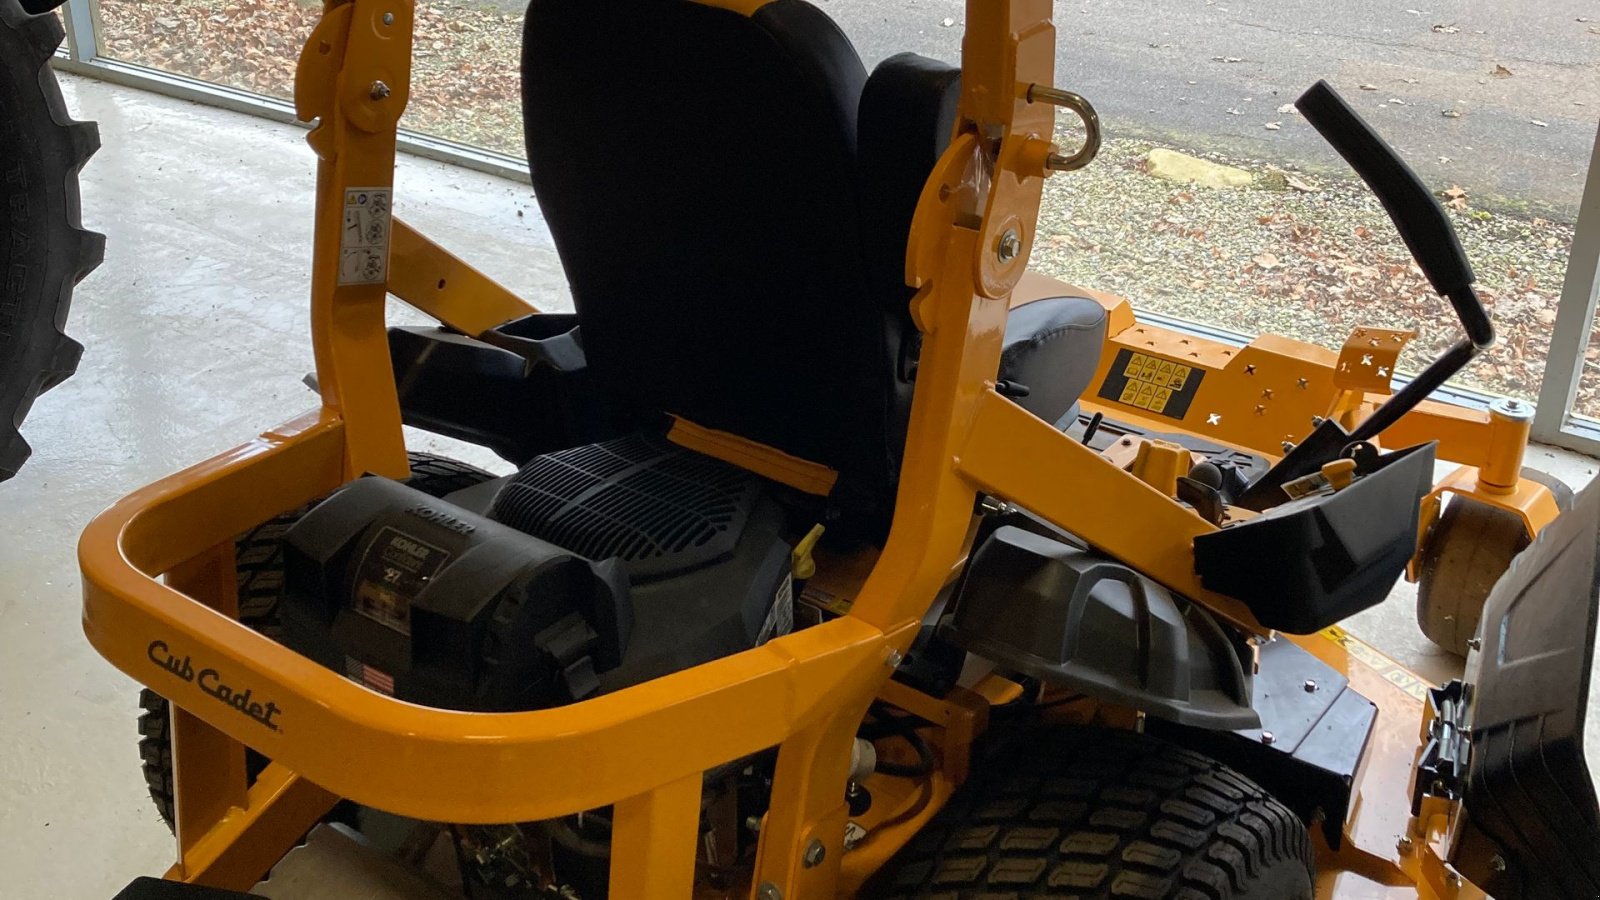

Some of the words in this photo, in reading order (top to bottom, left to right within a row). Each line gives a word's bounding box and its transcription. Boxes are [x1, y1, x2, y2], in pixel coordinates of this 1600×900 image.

[404, 503, 476, 535] KOHLER
[147, 639, 194, 683] Cub
[197, 668, 281, 731] Cadet
